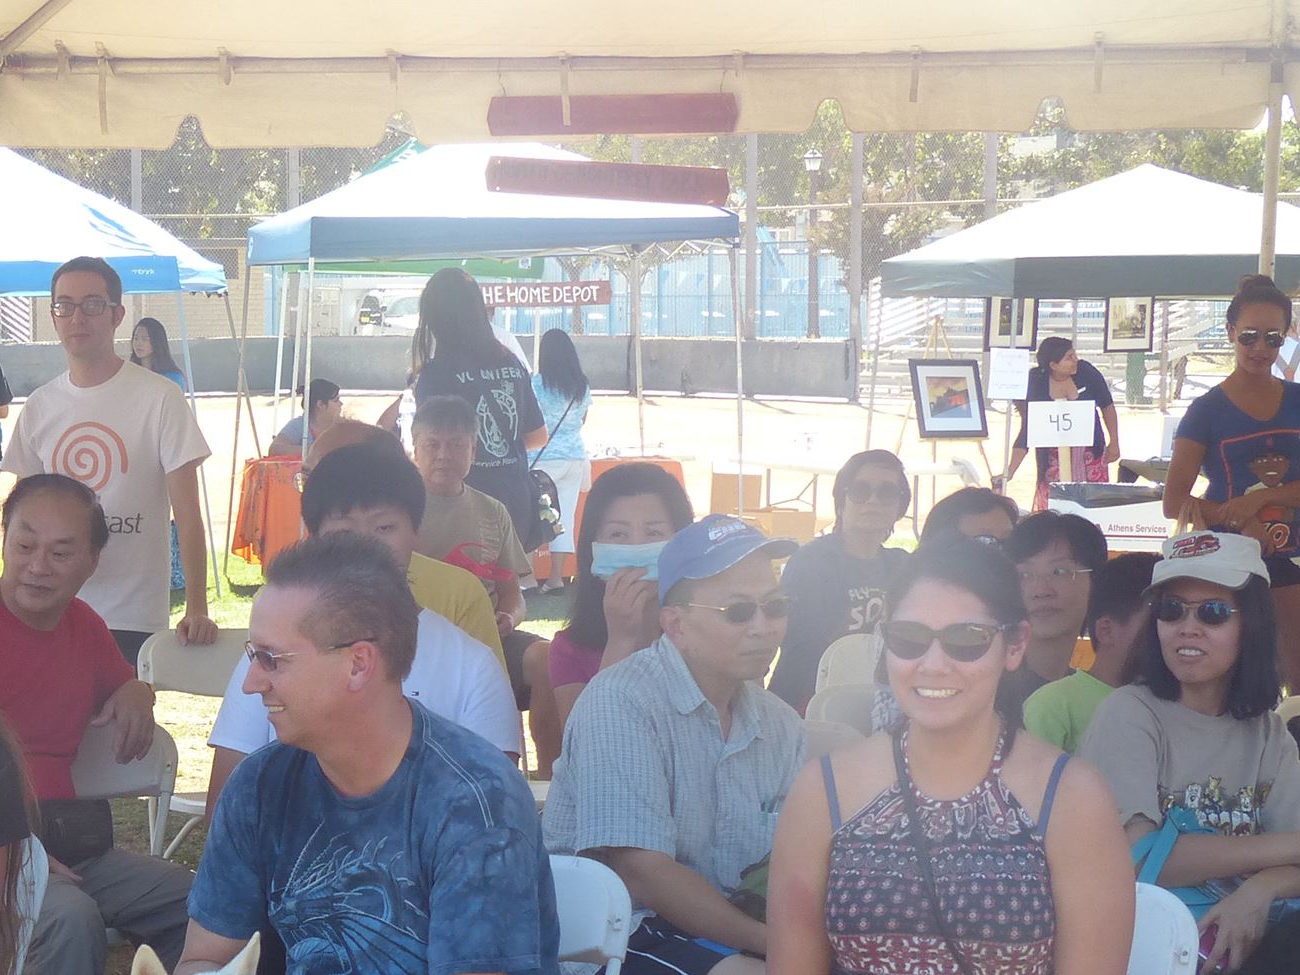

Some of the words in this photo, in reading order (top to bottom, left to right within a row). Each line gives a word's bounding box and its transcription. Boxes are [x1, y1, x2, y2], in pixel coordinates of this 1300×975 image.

[479, 285, 505, 304] HE
[507, 285, 550, 304] HOME
[553, 285, 599, 303] DEPOT
[1049, 413, 1072, 431] 45
[1108, 523, 1134, 533] Athens
[1136, 524, 1167, 533] Services
